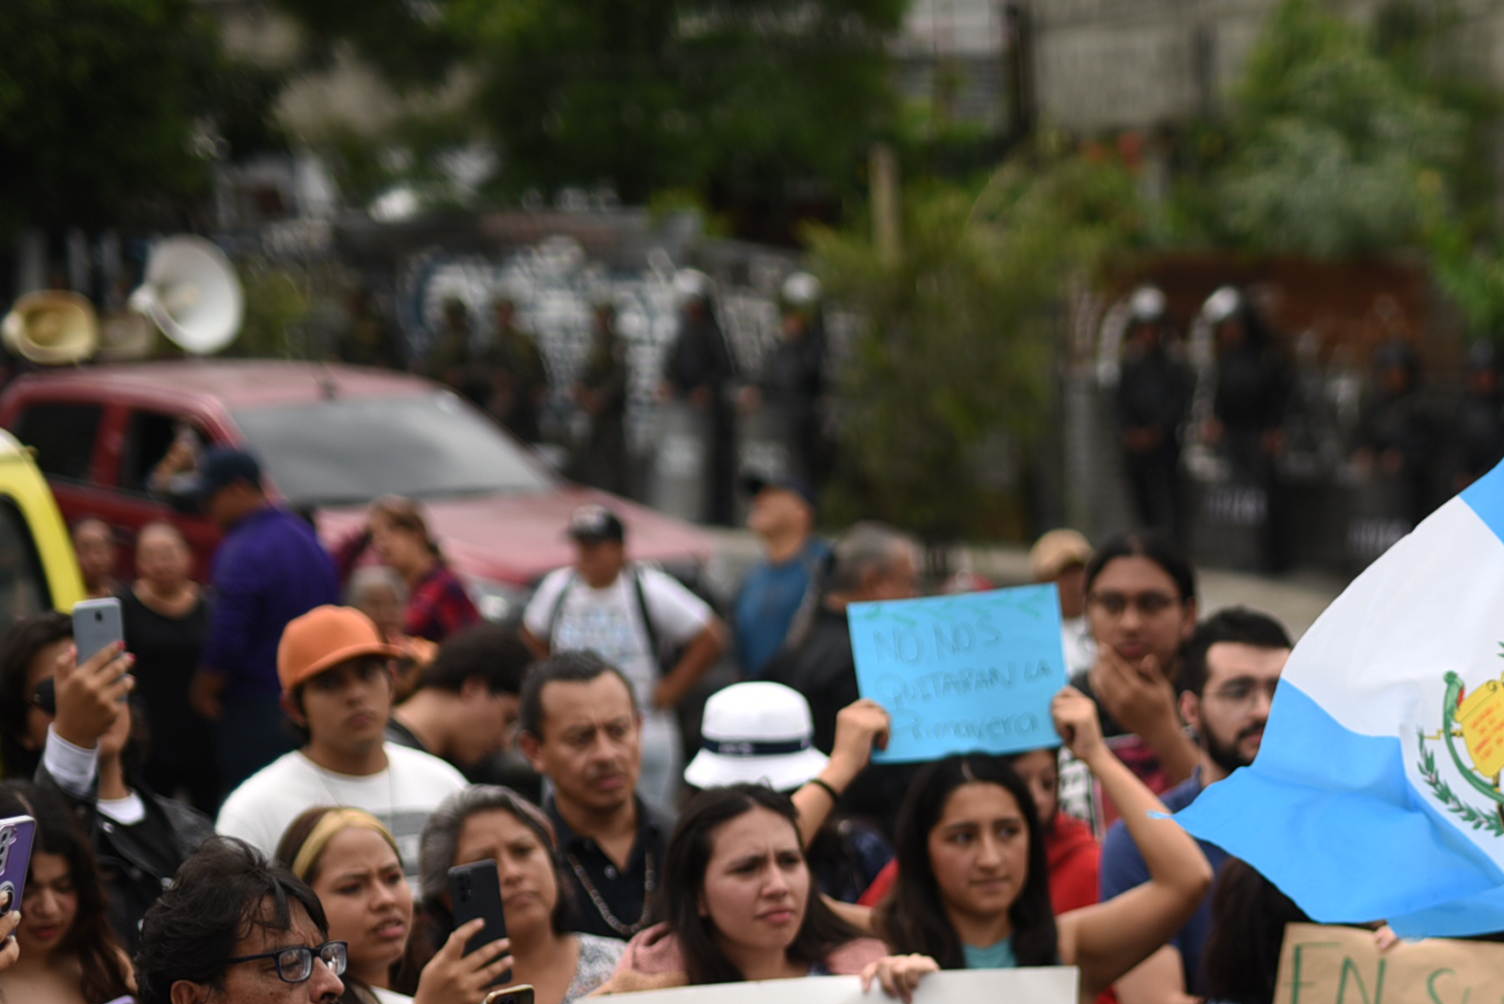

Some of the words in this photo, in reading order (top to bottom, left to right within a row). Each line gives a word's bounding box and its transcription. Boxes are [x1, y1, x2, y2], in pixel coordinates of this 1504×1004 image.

[872, 623, 924, 667] NO
[933, 614, 1002, 663] NOS
[1023, 658, 1051, 681] LA
